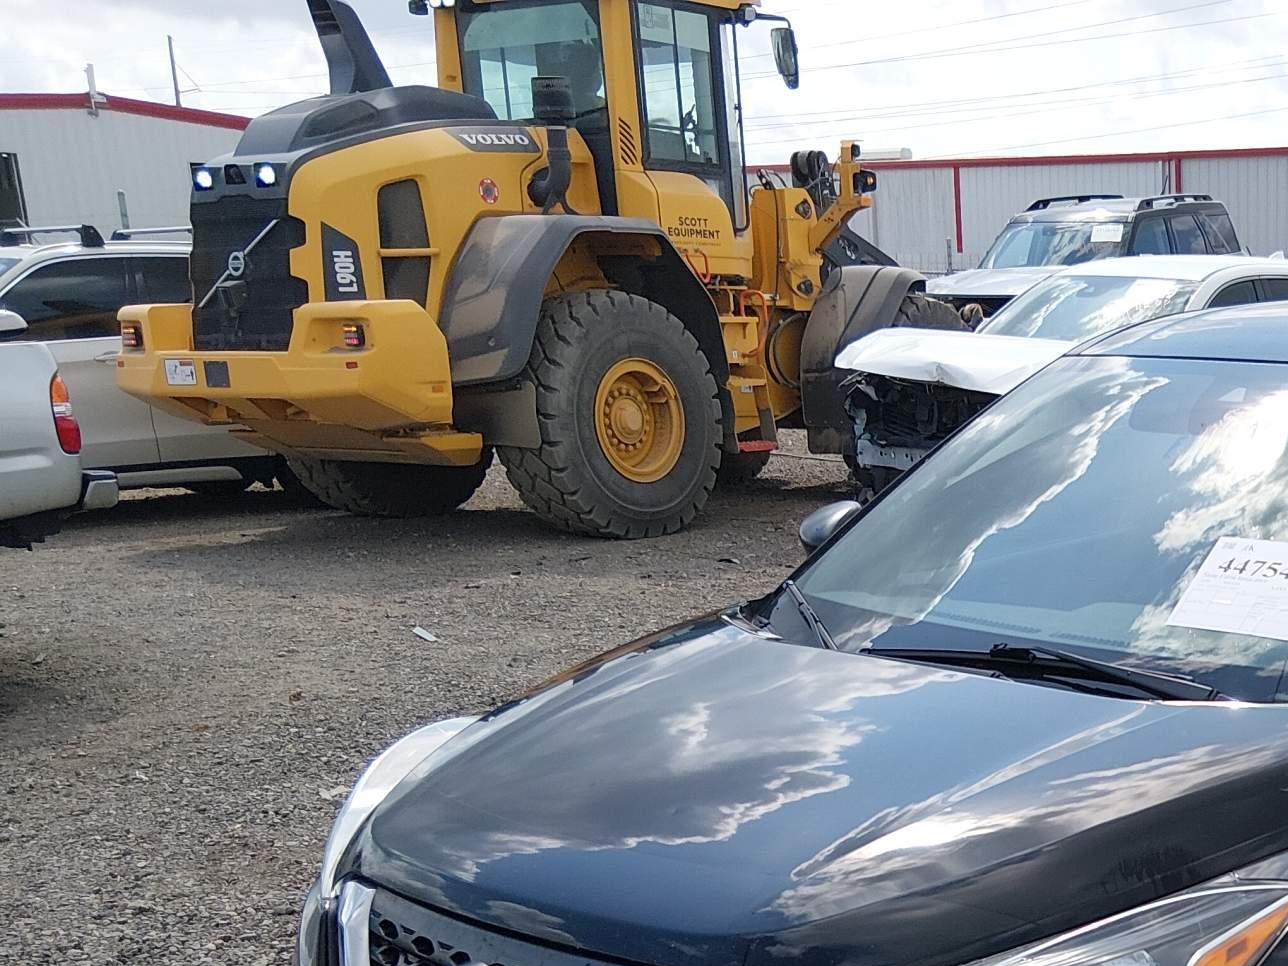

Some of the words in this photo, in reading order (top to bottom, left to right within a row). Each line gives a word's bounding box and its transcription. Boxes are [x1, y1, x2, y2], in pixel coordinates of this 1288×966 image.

[459, 134, 529, 145] VOLVO
[678, 216, 709, 228] SCOTT
[667, 226, 720, 240] EQUIPMENT
[332, 250, 359, 292] L90H
